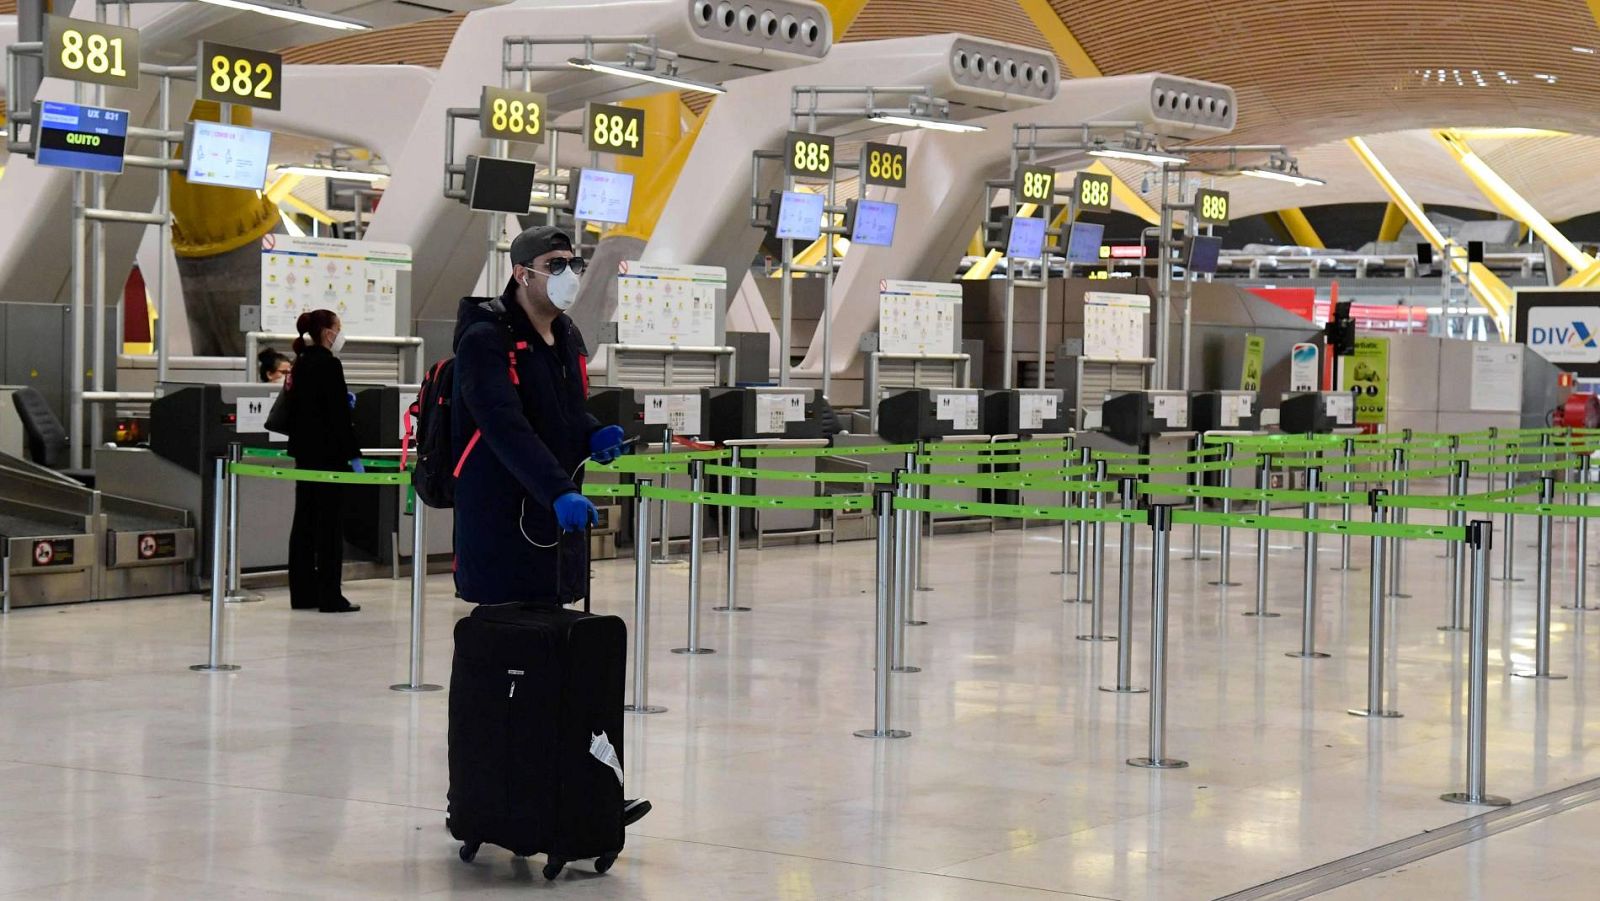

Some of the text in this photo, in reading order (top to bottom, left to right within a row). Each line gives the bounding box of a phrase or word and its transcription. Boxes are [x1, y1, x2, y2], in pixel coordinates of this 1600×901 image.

[61, 30, 126, 77] 881
[210, 55, 273, 100] 882
[492, 98, 540, 135] 883
[594, 113, 639, 149] 884
[66, 132, 101, 147] QUITO
[794, 140, 830, 172] 885
[869, 150, 903, 181] 886
[1023, 171, 1052, 200] 887
[1081, 179, 1109, 206] 888
[1202, 194, 1227, 220] 889
